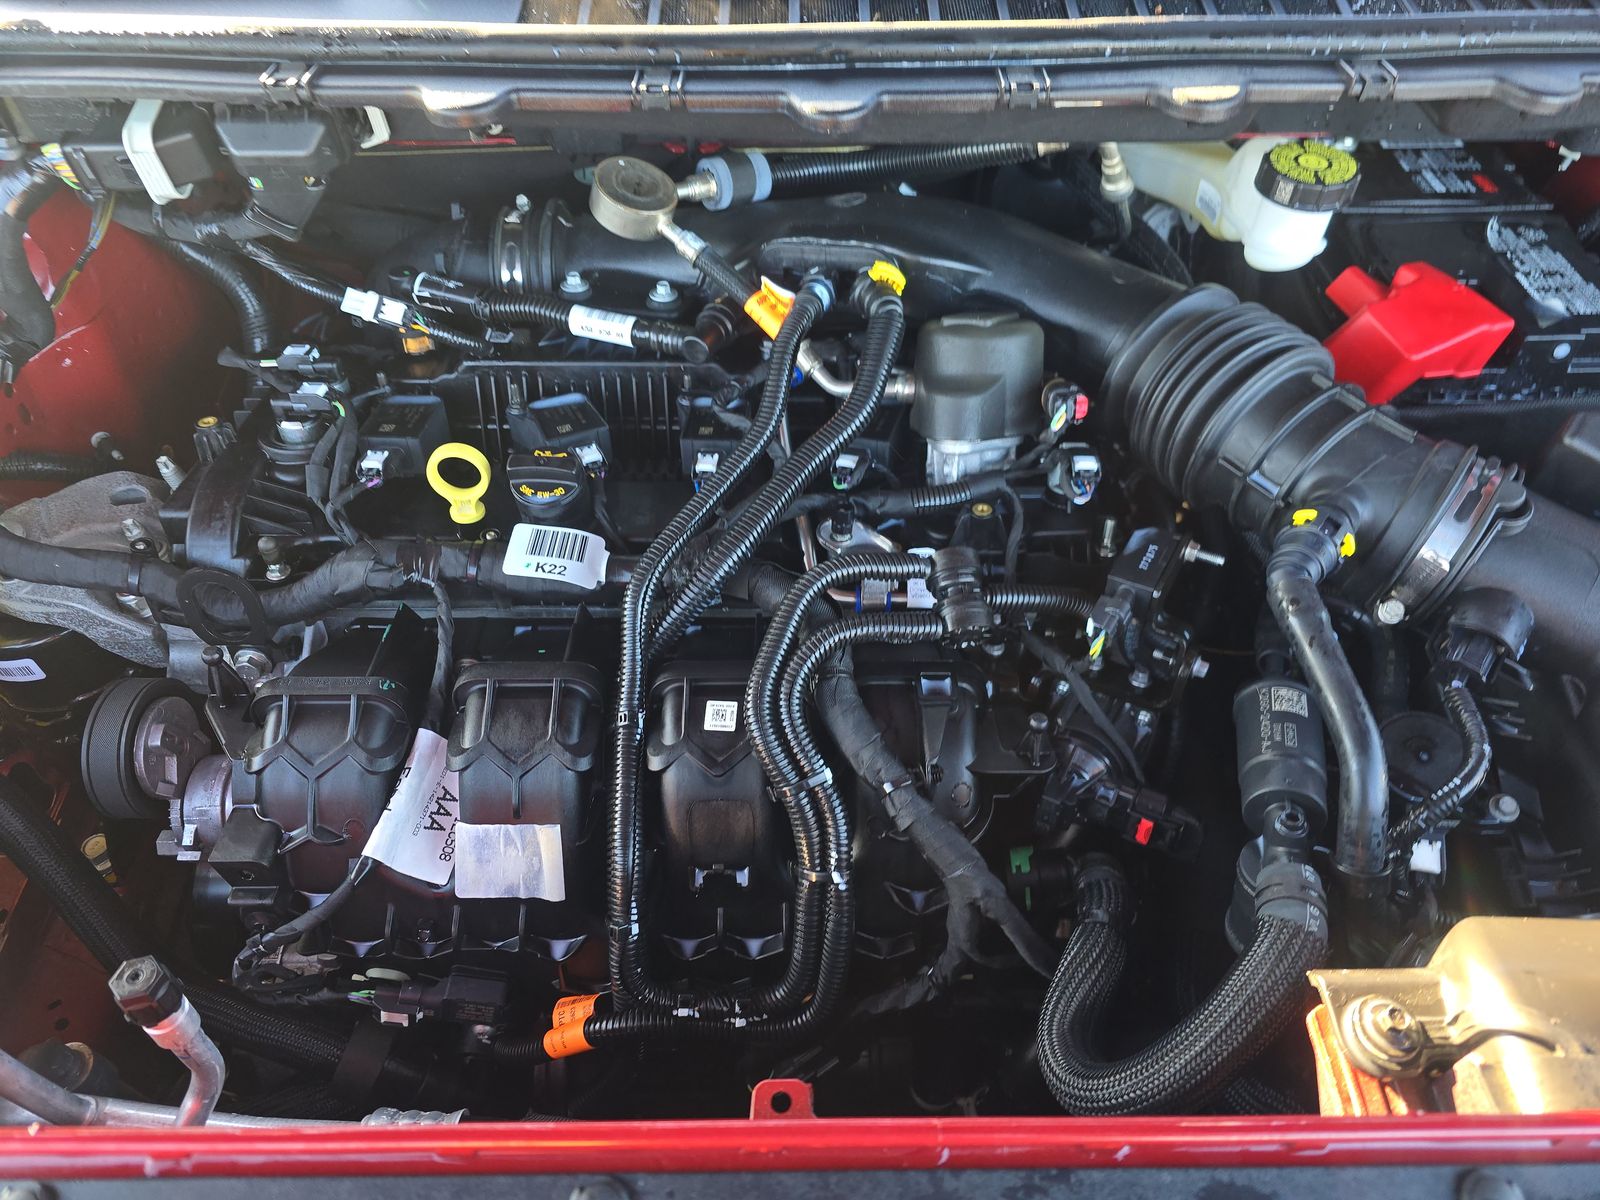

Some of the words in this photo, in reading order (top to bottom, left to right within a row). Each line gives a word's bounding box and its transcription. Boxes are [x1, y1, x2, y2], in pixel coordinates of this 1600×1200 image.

[519, 484, 535, 496] SAE
[534, 561, 568, 577] K22
[423, 785, 458, 832] AAA
